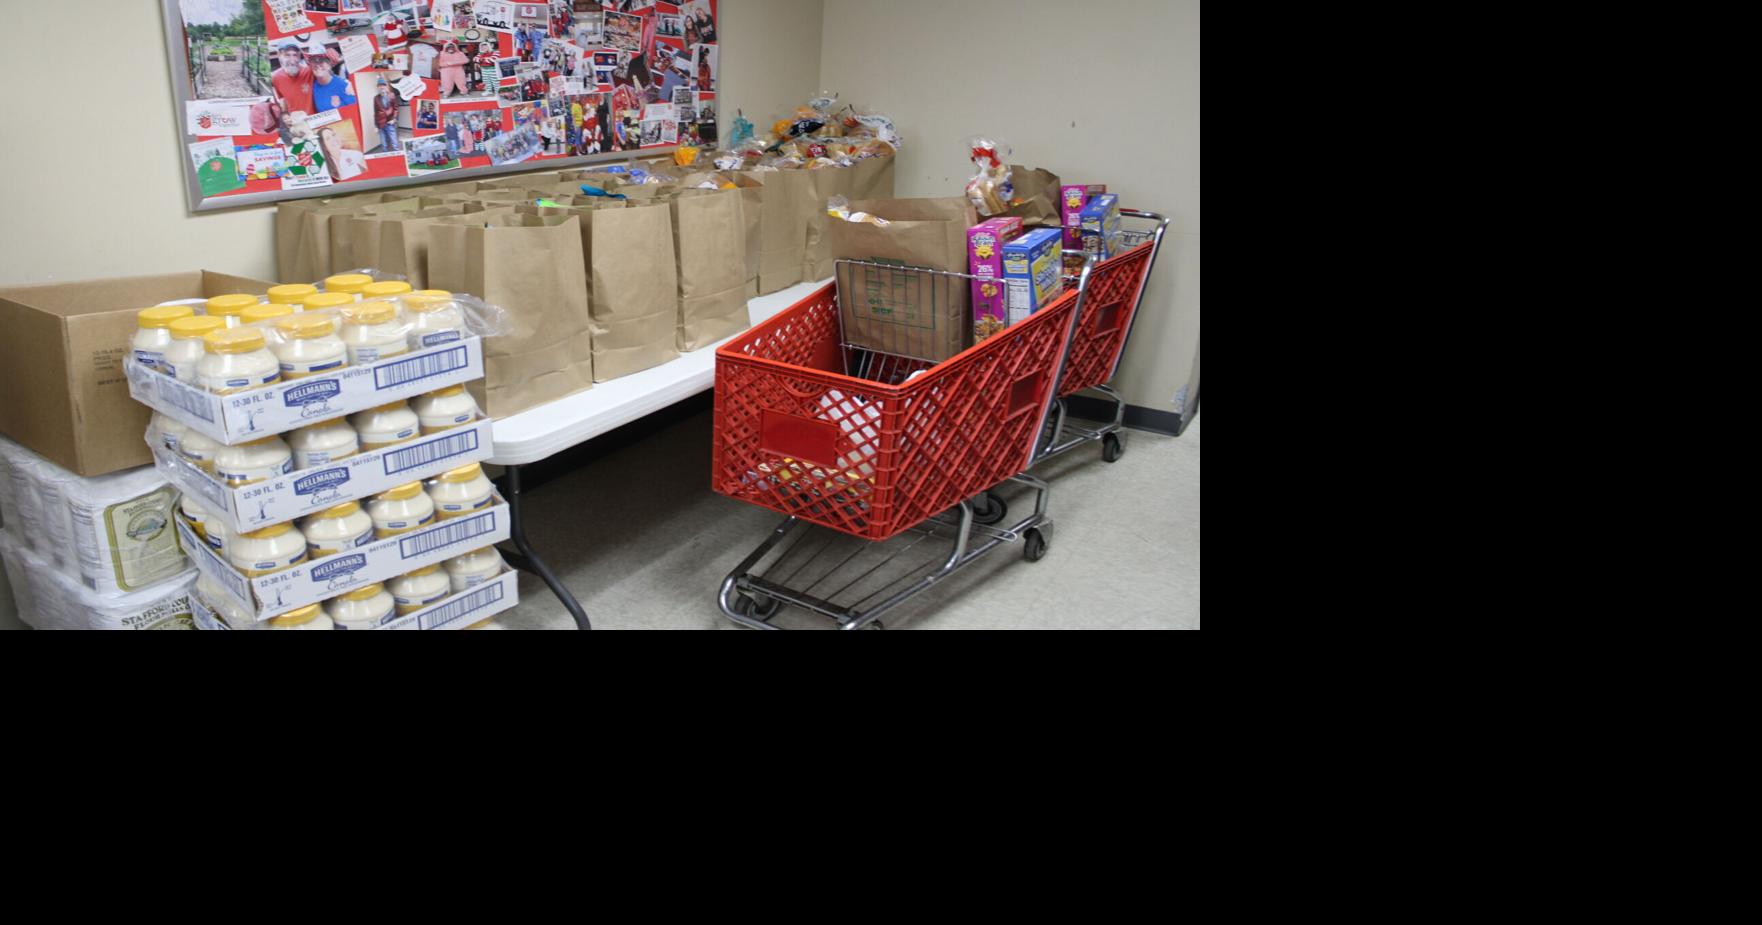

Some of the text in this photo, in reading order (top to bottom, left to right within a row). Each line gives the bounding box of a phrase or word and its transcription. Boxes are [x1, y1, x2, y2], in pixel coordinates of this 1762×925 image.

[287, 381, 337, 402] HELLMANN'S
[232, 397, 251, 408] 12-30
[297, 468, 347, 490] HELLMANN'S
[243, 488, 261, 499] 12-30
[314, 556, 364, 577] HELLMANN'S
[261, 577, 279, 588] 12-30
